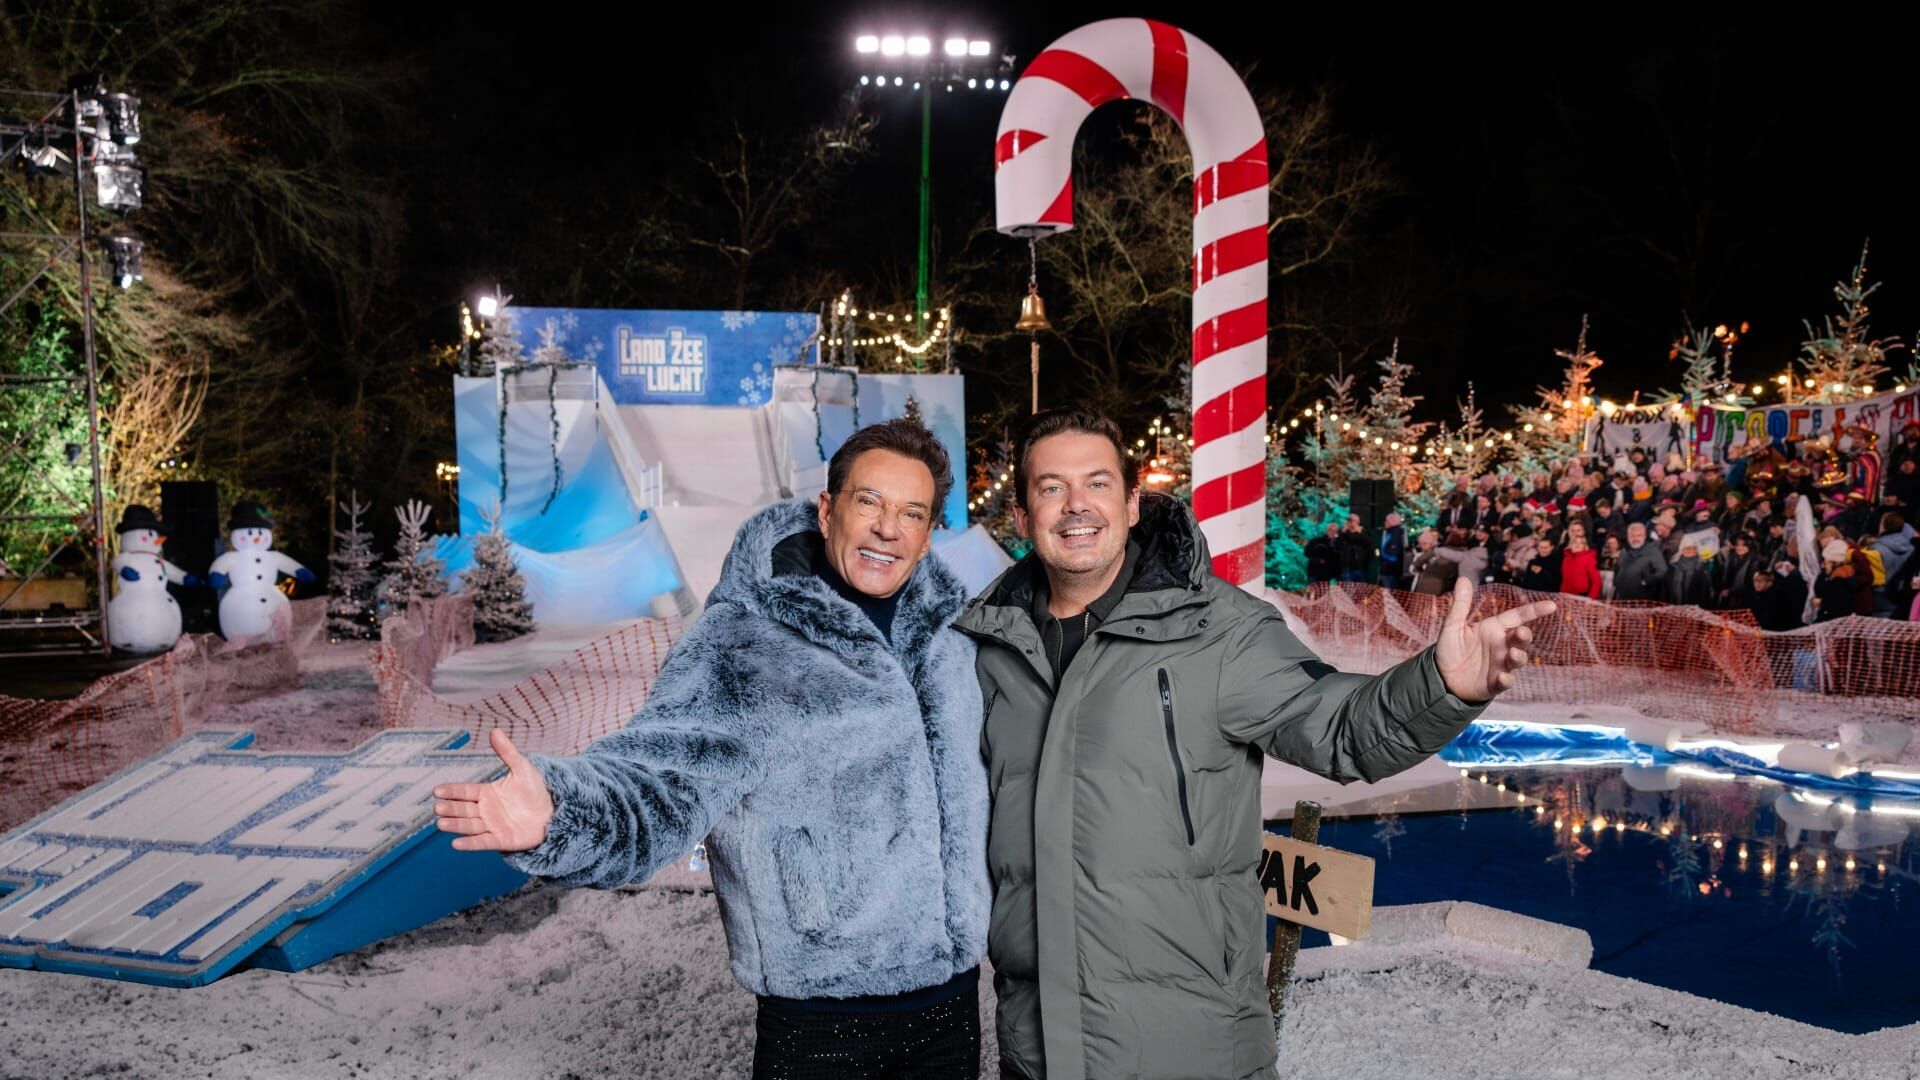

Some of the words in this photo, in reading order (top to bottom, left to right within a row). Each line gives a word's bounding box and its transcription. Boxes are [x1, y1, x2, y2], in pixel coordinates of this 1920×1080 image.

[620, 337, 666, 365] LAND
[671, 335, 703, 365] ZEE
[647, 366, 703, 392] LUCHT
